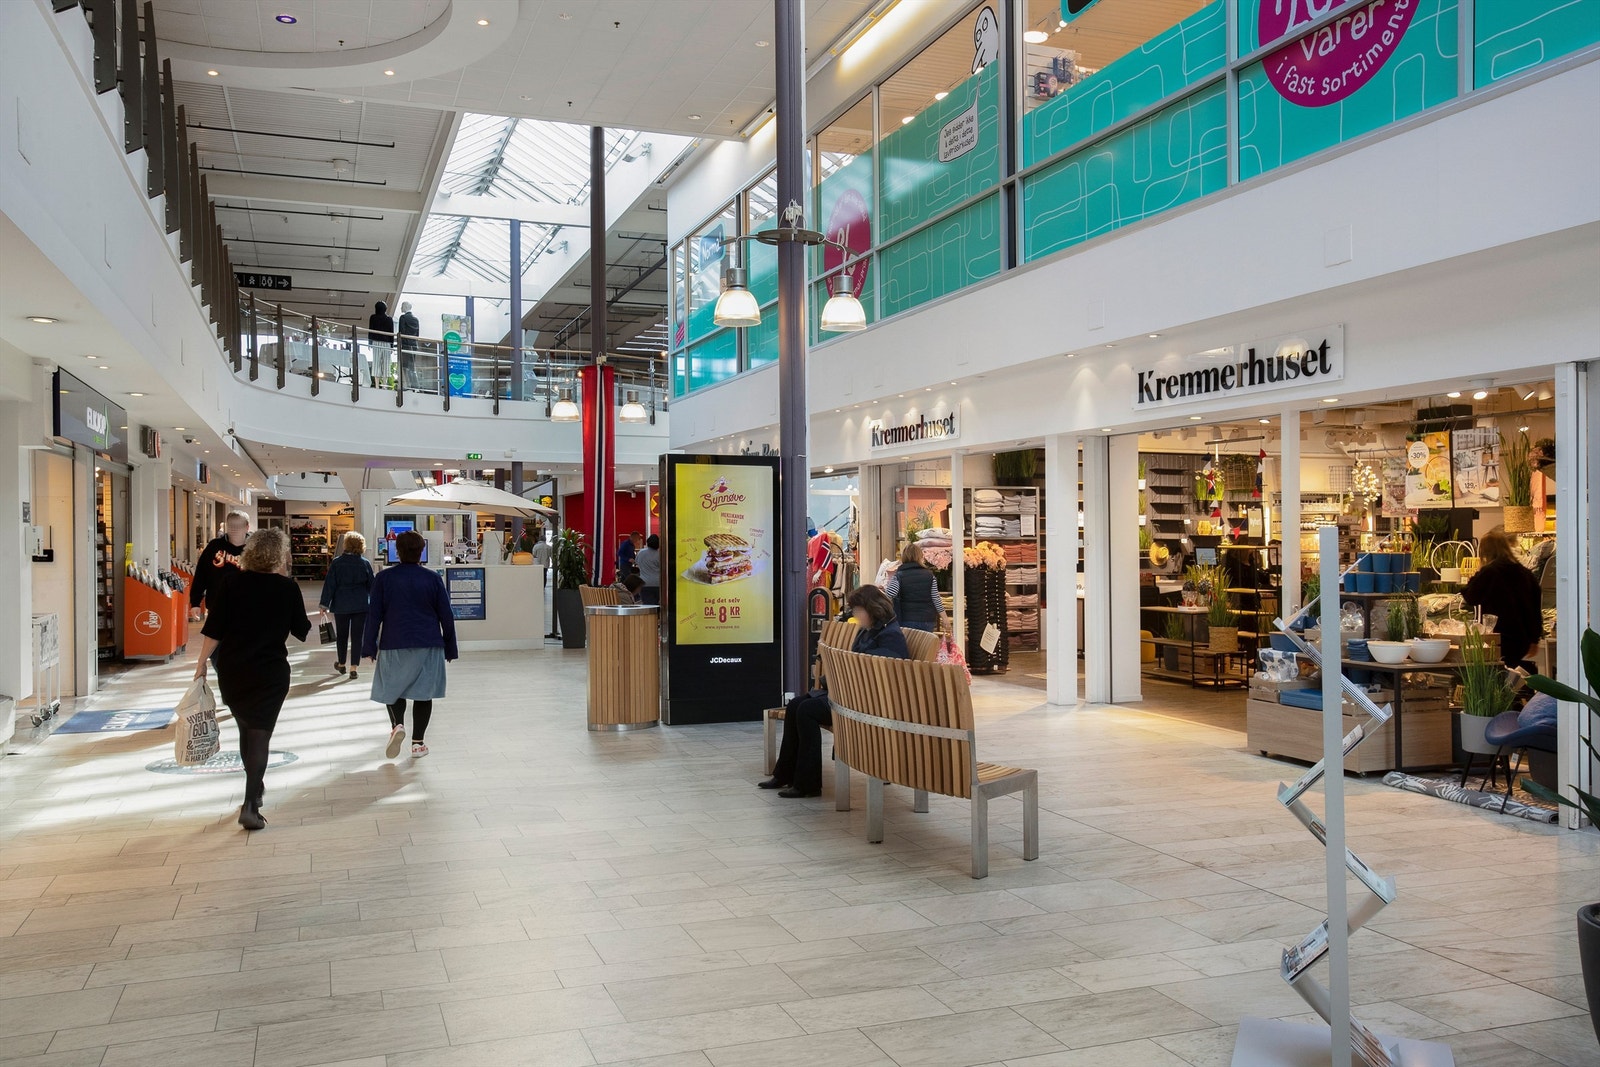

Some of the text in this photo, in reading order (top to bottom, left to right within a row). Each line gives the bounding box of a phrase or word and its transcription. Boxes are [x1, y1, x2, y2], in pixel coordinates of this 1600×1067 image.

[1276, 56, 1288, 74] i
[1283, 65, 1316, 95] fast
[1321, 0, 1410, 96] sortiment
[1300, 1, 1384, 61] varer
[702, 231, 722, 263] Normal
[1138, 338, 1332, 404] Kremmerhuset
[872, 411, 956, 447] Kremmerhuset
[700, 493, 747, 512] Synnøve
[704, 606, 741, 623] CA. 8 KR
